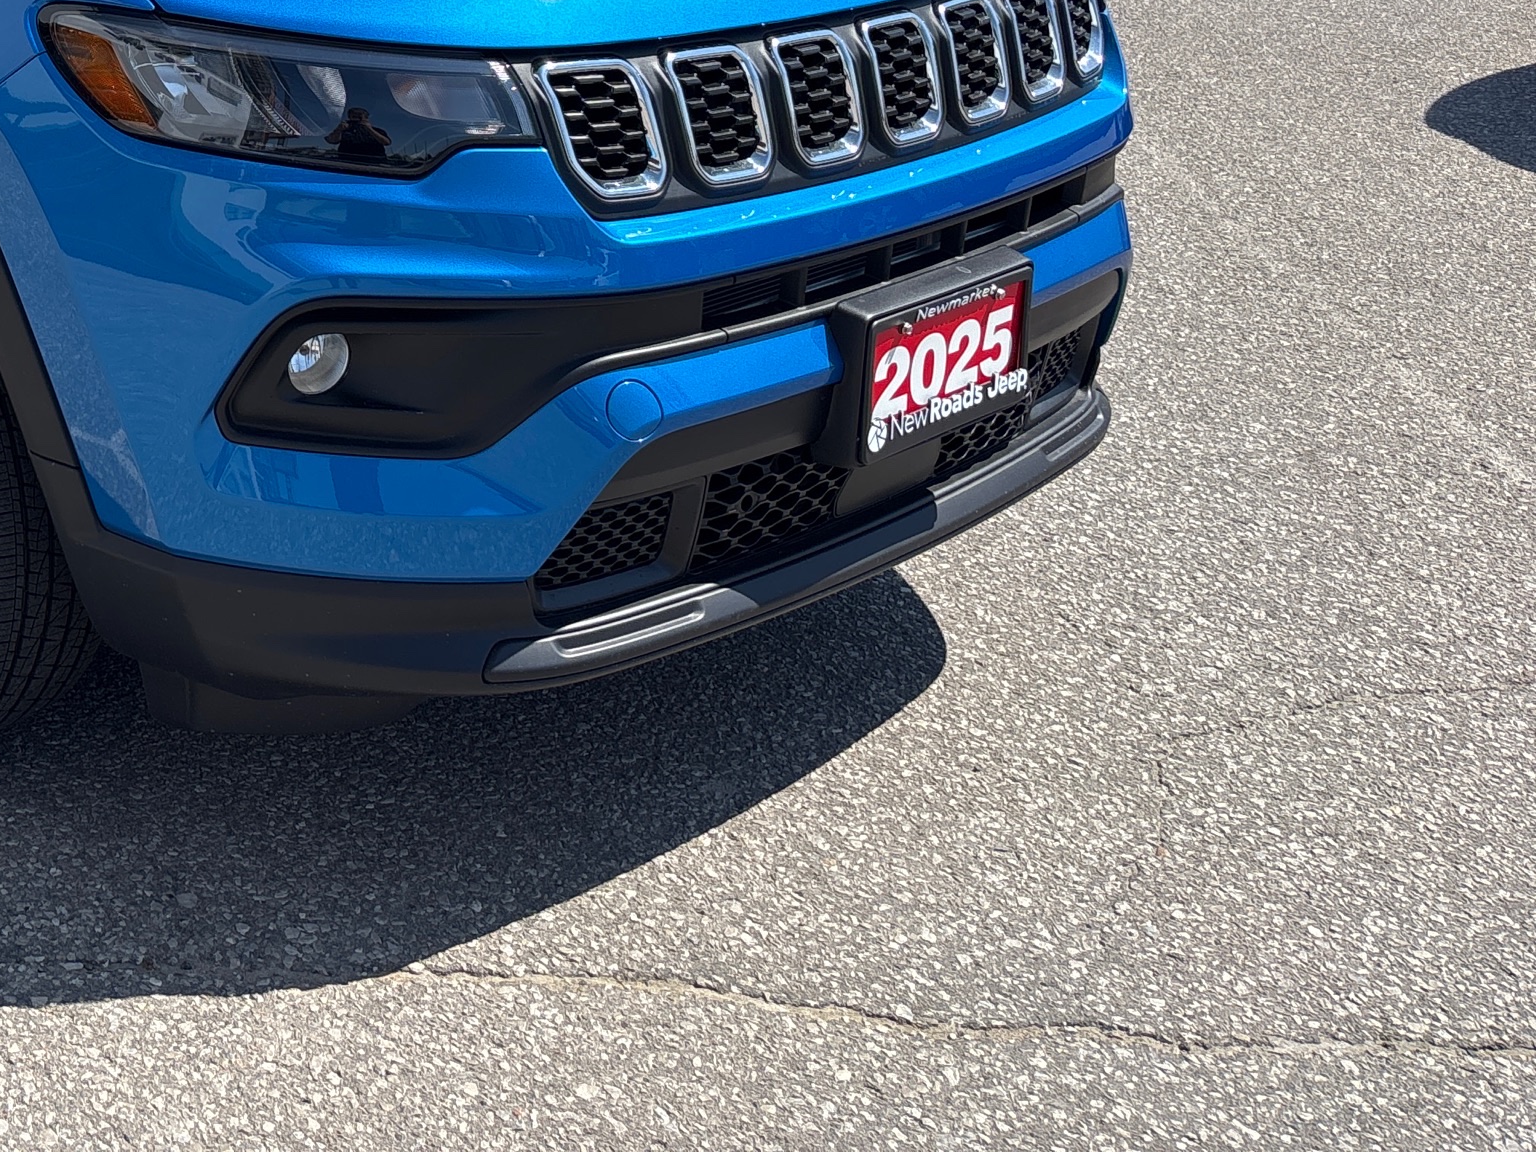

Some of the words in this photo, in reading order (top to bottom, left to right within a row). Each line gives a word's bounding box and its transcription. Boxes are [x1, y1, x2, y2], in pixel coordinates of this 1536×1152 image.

[915, 284, 998, 323] Newmarket
[870, 303, 1015, 423] 2025
[987, 368, 1028, 399] Jeep
